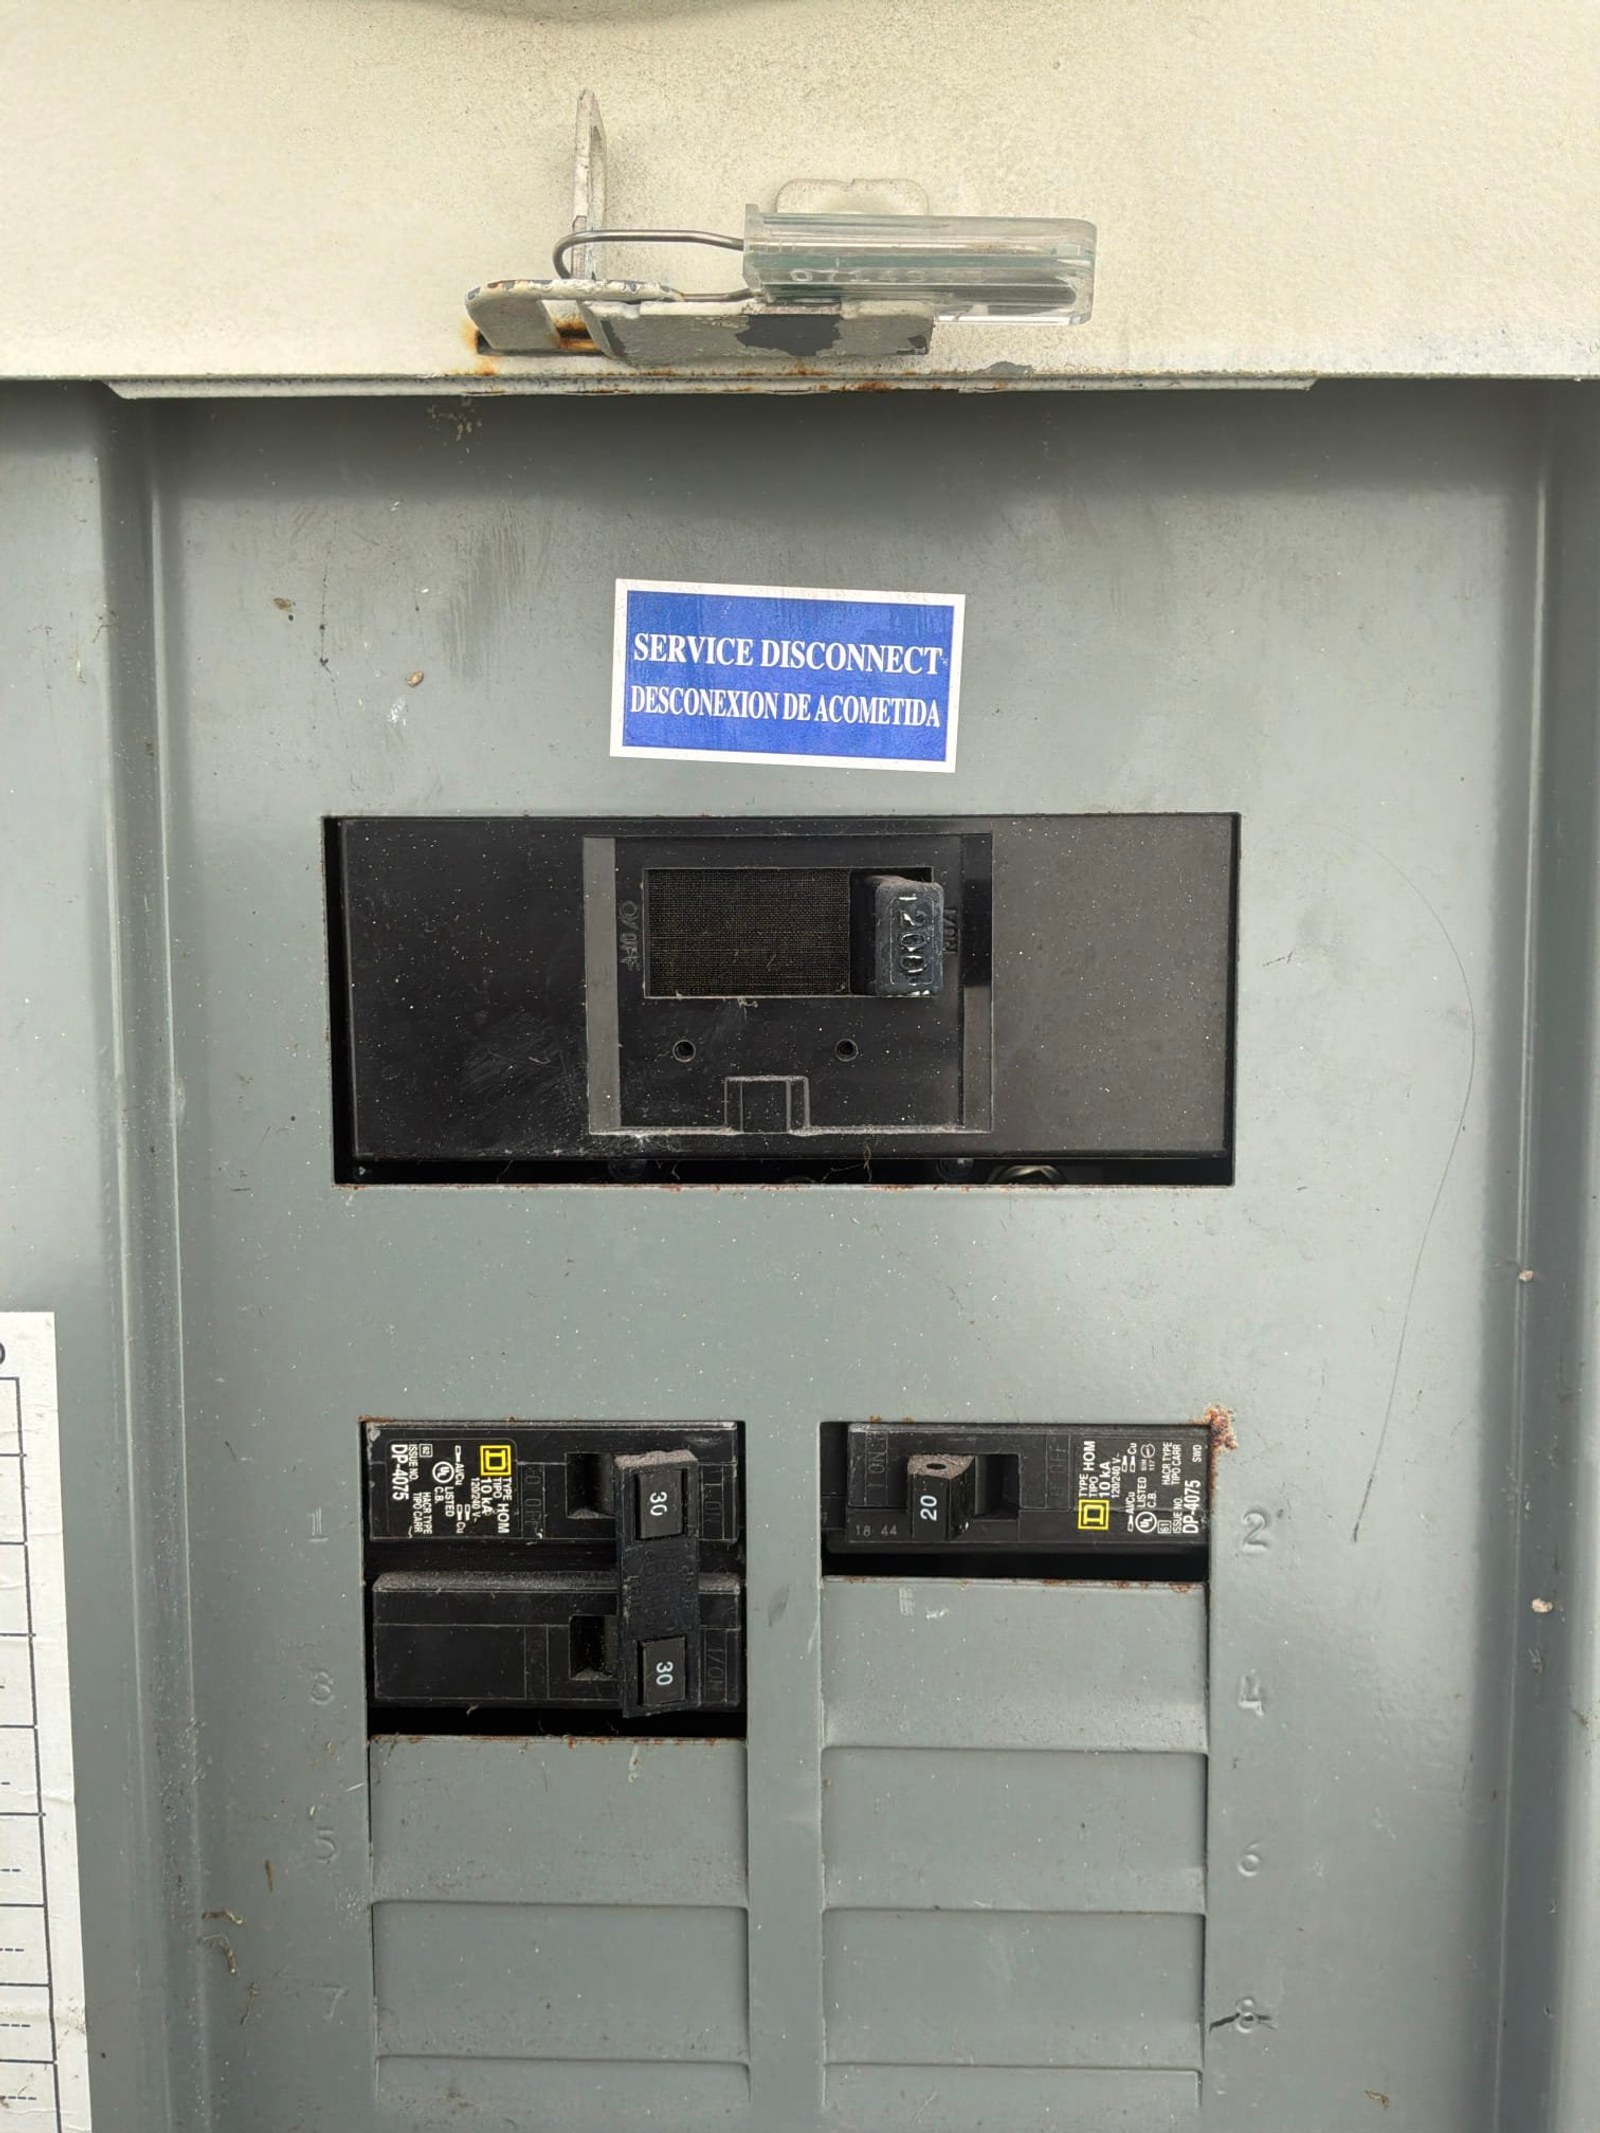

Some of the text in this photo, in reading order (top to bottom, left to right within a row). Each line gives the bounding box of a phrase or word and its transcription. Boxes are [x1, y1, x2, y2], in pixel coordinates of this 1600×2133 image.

[633, 633, 943, 675] SERVICE DISCONNECT
[631, 685, 941, 728] DESCONEXION DE ACOMETIDA
[409, 1444, 417, 1482] ISSUE NO.
[1128, 1443, 1136, 1454] Cu
[1162, 1442, 1172, 1485] HACR TYPE
[1171, 1444, 1181, 1485] TIPO CARR
[1193, 1445, 1202, 1462] SWD
[391, 1444, 408, 1500] DP-4075
[1079, 1441, 1095, 1497] TYPE HOM
[1089, 1476, 1098, 1497] TIPO
[1099, 1462, 1110, 1497] 10 kA
[1111, 1466, 1121, 1498] 120/240
[435, 1486, 443, 1504] C.B.
[445, 1486, 454, 1516] LISTED
[471, 1478, 480, 1509] 120/240
[481, 1478, 491, 1514] 10 kA
[493, 1478, 502, 1498] TIPO
[497, 1477, 511, 1533] TYPE HOM
[650, 1490, 668, 1517] 30
[1138, 1477, 1146, 1508] LISTED
[1148, 1491, 1156, 1508] C.B.
[413, 1492, 422, 1532] TIPO CARR
[423, 1492, 431, 1534] HACR TYPE
[920, 1495, 938, 1521] 20
[1173, 1496, 1182, 1533] ISSUE NO.
[1184, 1480, 1200, 1533] DP-4075
[308, 1508, 328, 1542] 1
[456, 1522, 465, 1533] Cu
[855, 1525, 897, 1537] 18 44
[1241, 1511, 1269, 1551] 2
[656, 1661, 673, 1686] 30
[313, 1830, 338, 1865] 5
[1238, 1841, 1262, 1877] 6
[315, 1984, 346, 2024] 7
